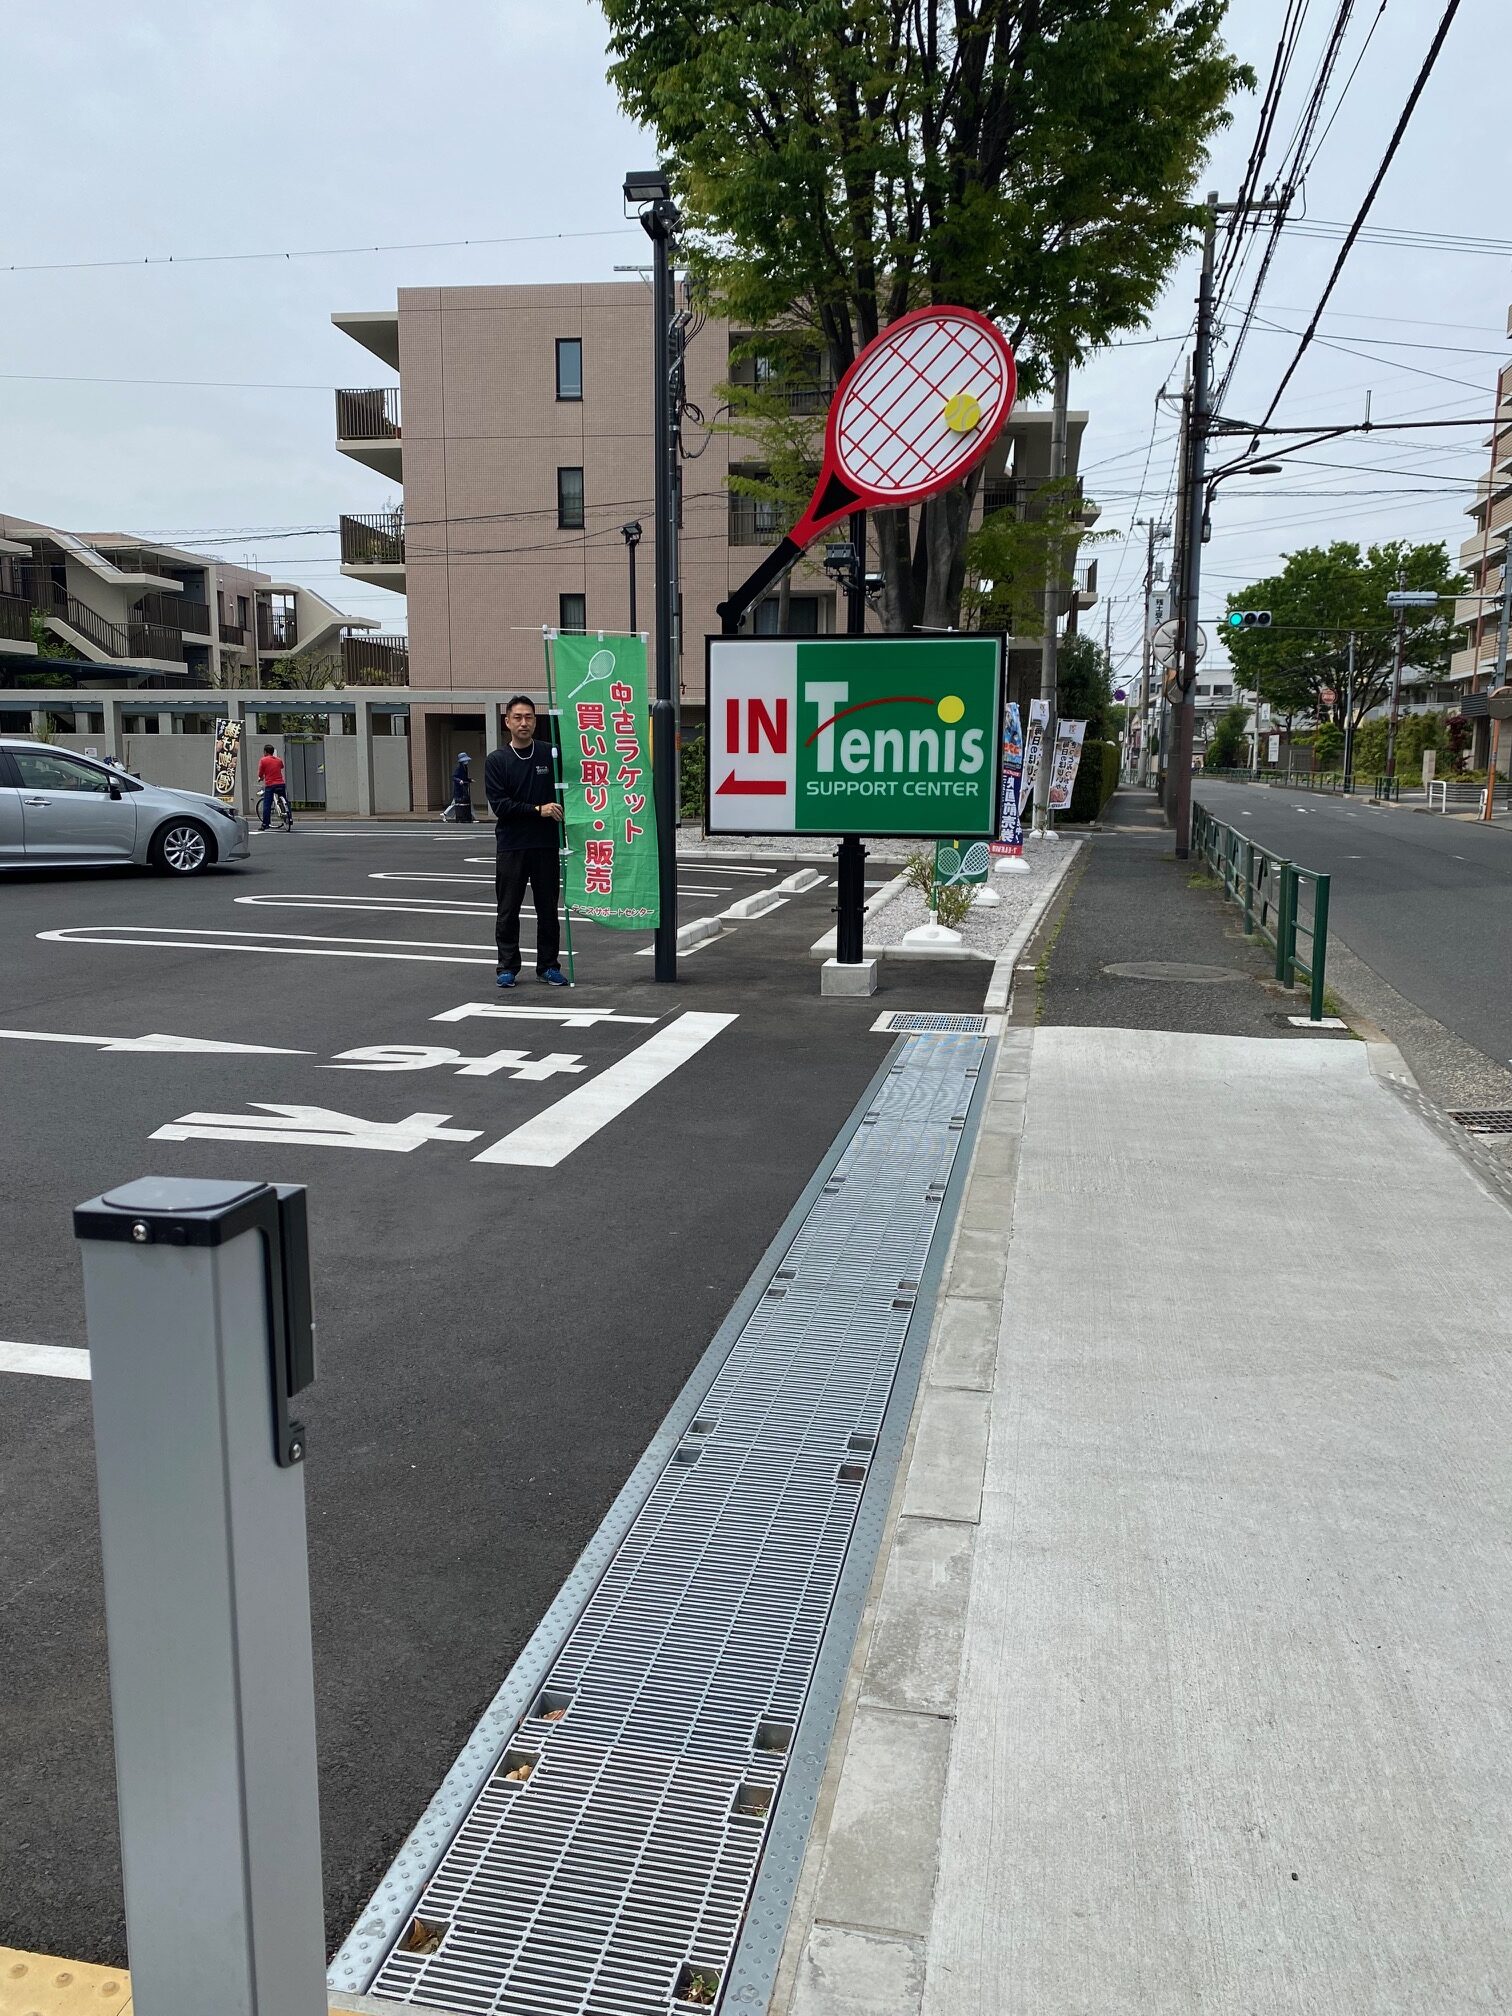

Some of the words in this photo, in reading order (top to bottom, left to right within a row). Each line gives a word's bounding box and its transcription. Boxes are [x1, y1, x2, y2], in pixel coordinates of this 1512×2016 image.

[610, 680, 646, 845] 中古ラケット
[726, 698, 788, 754] IN
[804, 681, 985, 775] Tennis
[575, 702, 615, 895] 買い取り・販売
[806, 781, 900, 796] SUPPORT
[902, 781, 979, 797] CENTER
[571, 904, 655, 918] テニスサポートセンター
